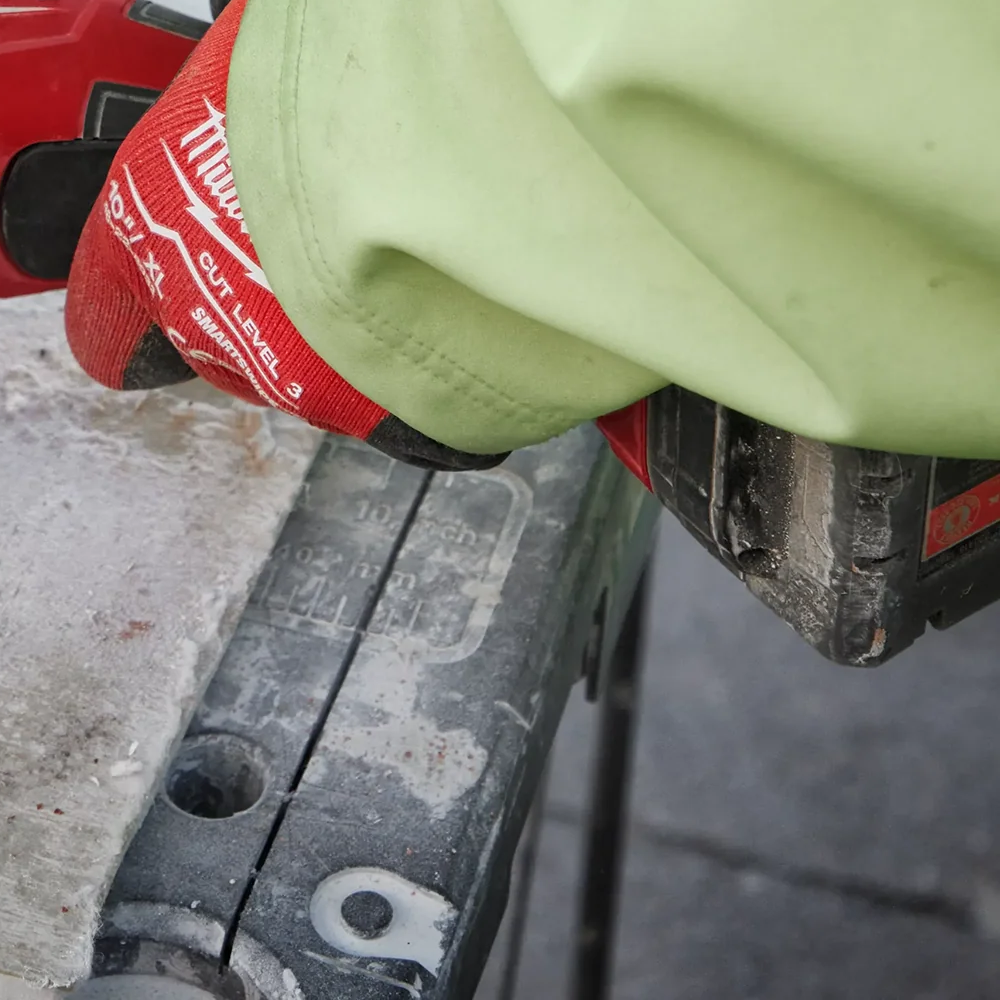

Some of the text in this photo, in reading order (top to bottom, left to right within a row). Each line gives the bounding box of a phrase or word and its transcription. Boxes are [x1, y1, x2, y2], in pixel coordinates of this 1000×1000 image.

[199, 250, 234, 299] CUT
[232, 302, 280, 381] LEVEL
[285, 381, 304, 400] 3
